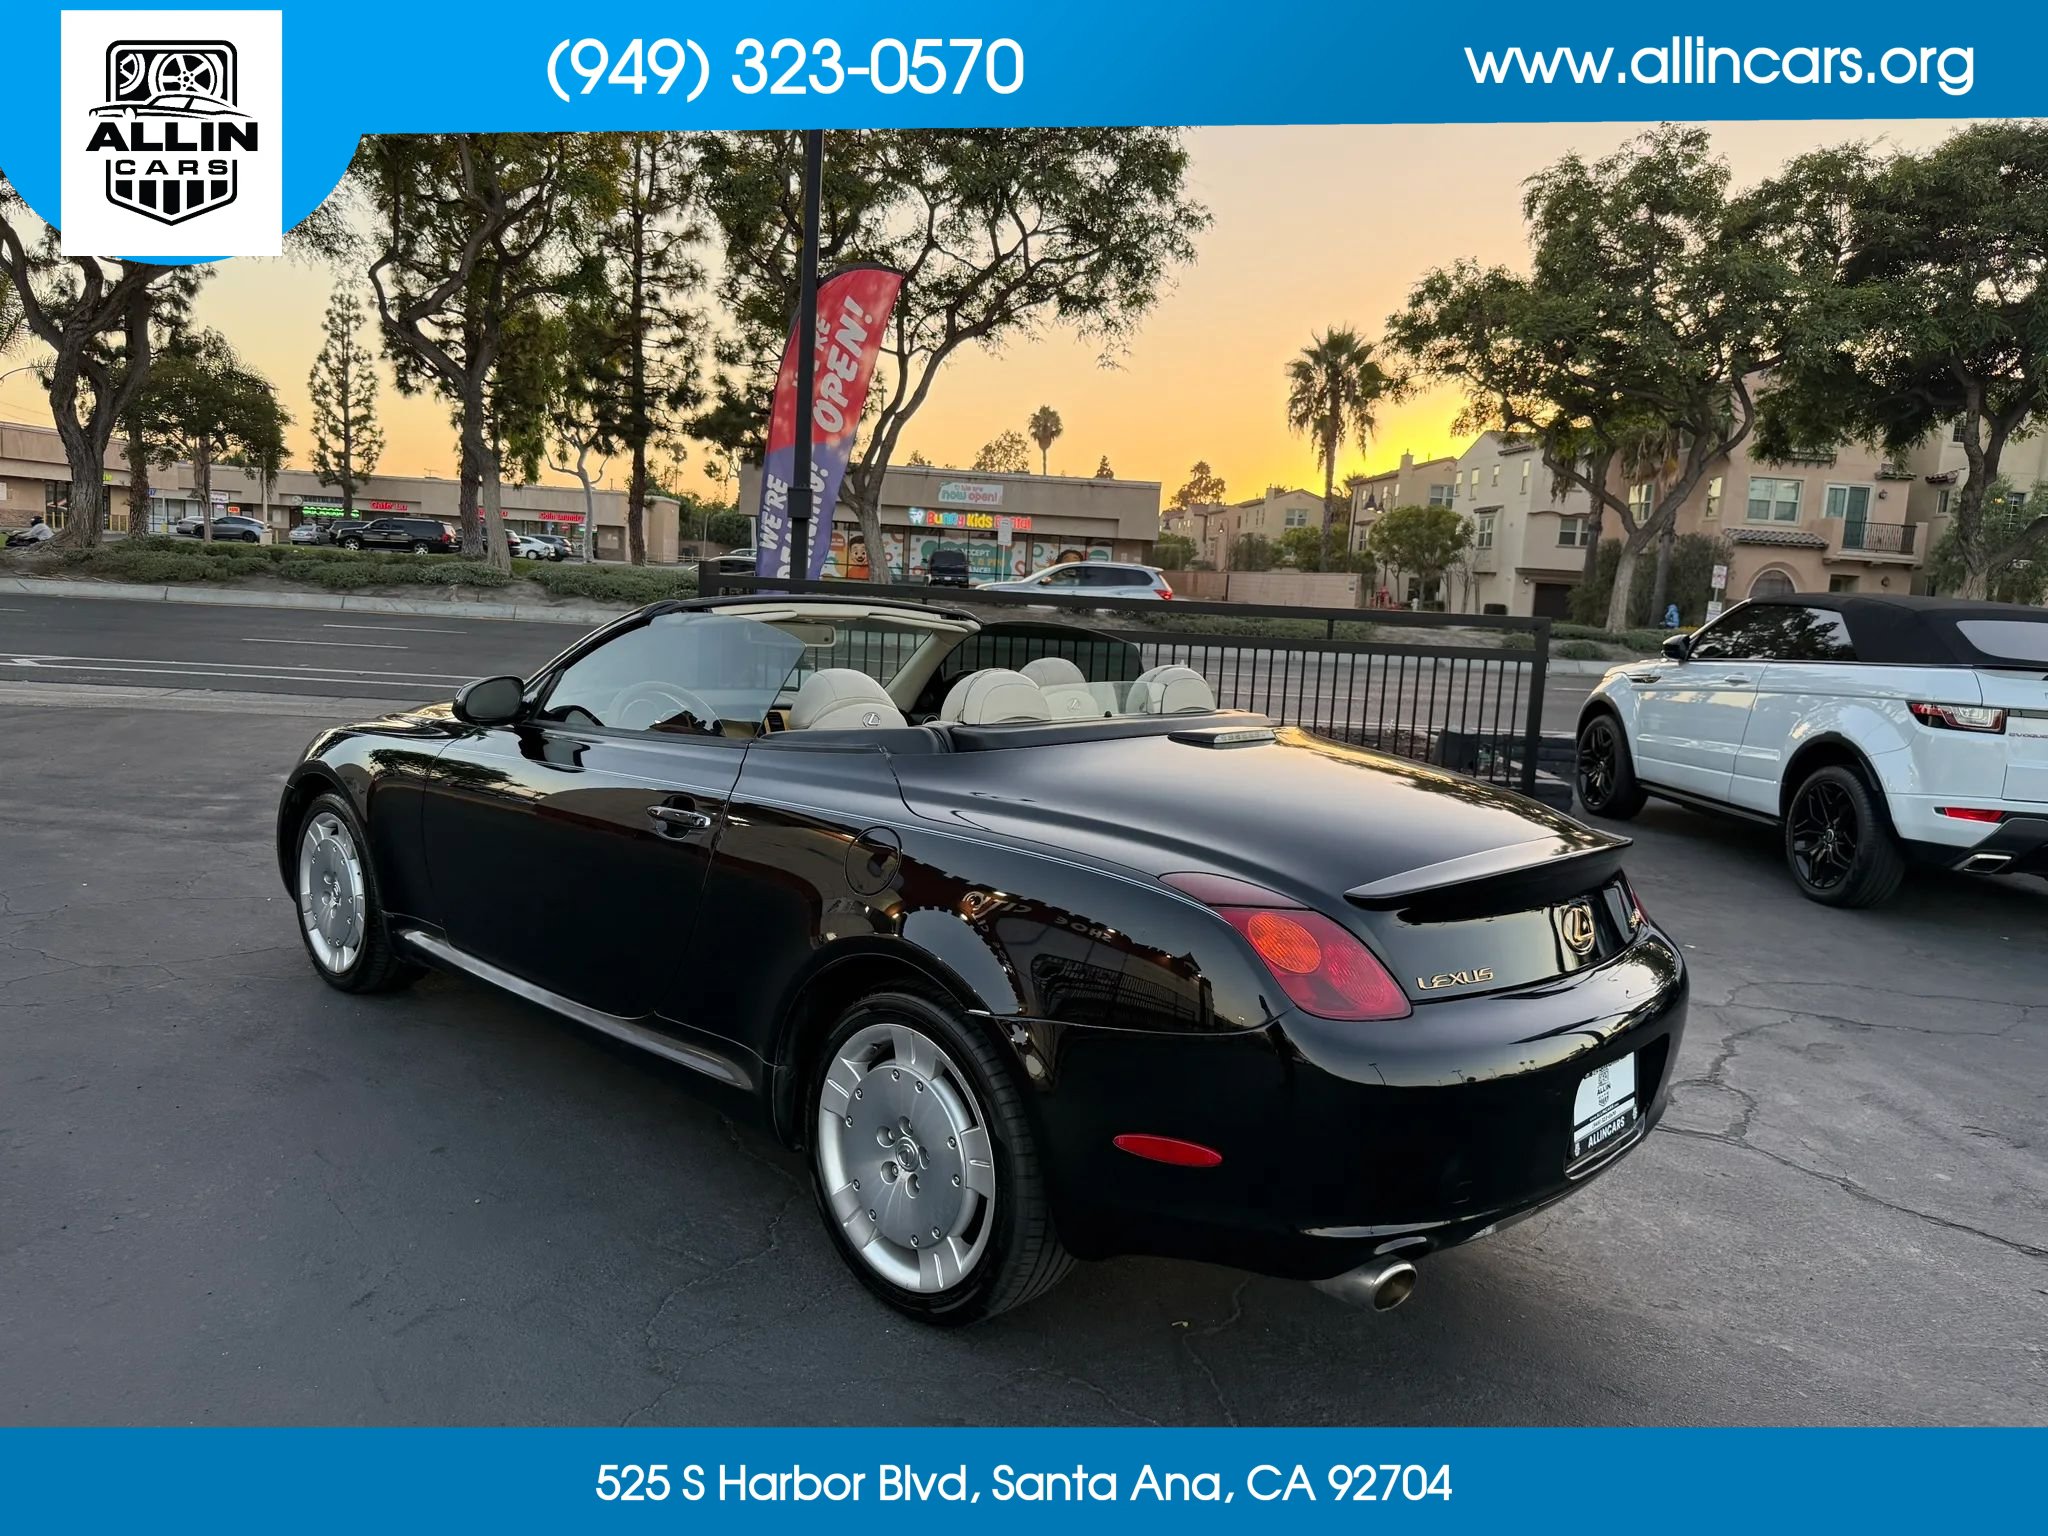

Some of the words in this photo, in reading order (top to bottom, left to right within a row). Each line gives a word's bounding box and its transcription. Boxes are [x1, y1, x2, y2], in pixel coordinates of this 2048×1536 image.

[811, 295, 874, 434] OPEN!
[942, 489, 967, 500] now
[968, 492, 998, 503] open!
[759, 473, 789, 552] WE'RE
[926, 511, 966, 528] Bunny
[966, 512, 993, 529] Kids
[1417, 967, 1494, 990] LEXUS
[1588, 1116, 1626, 1150] ALLINCARS
